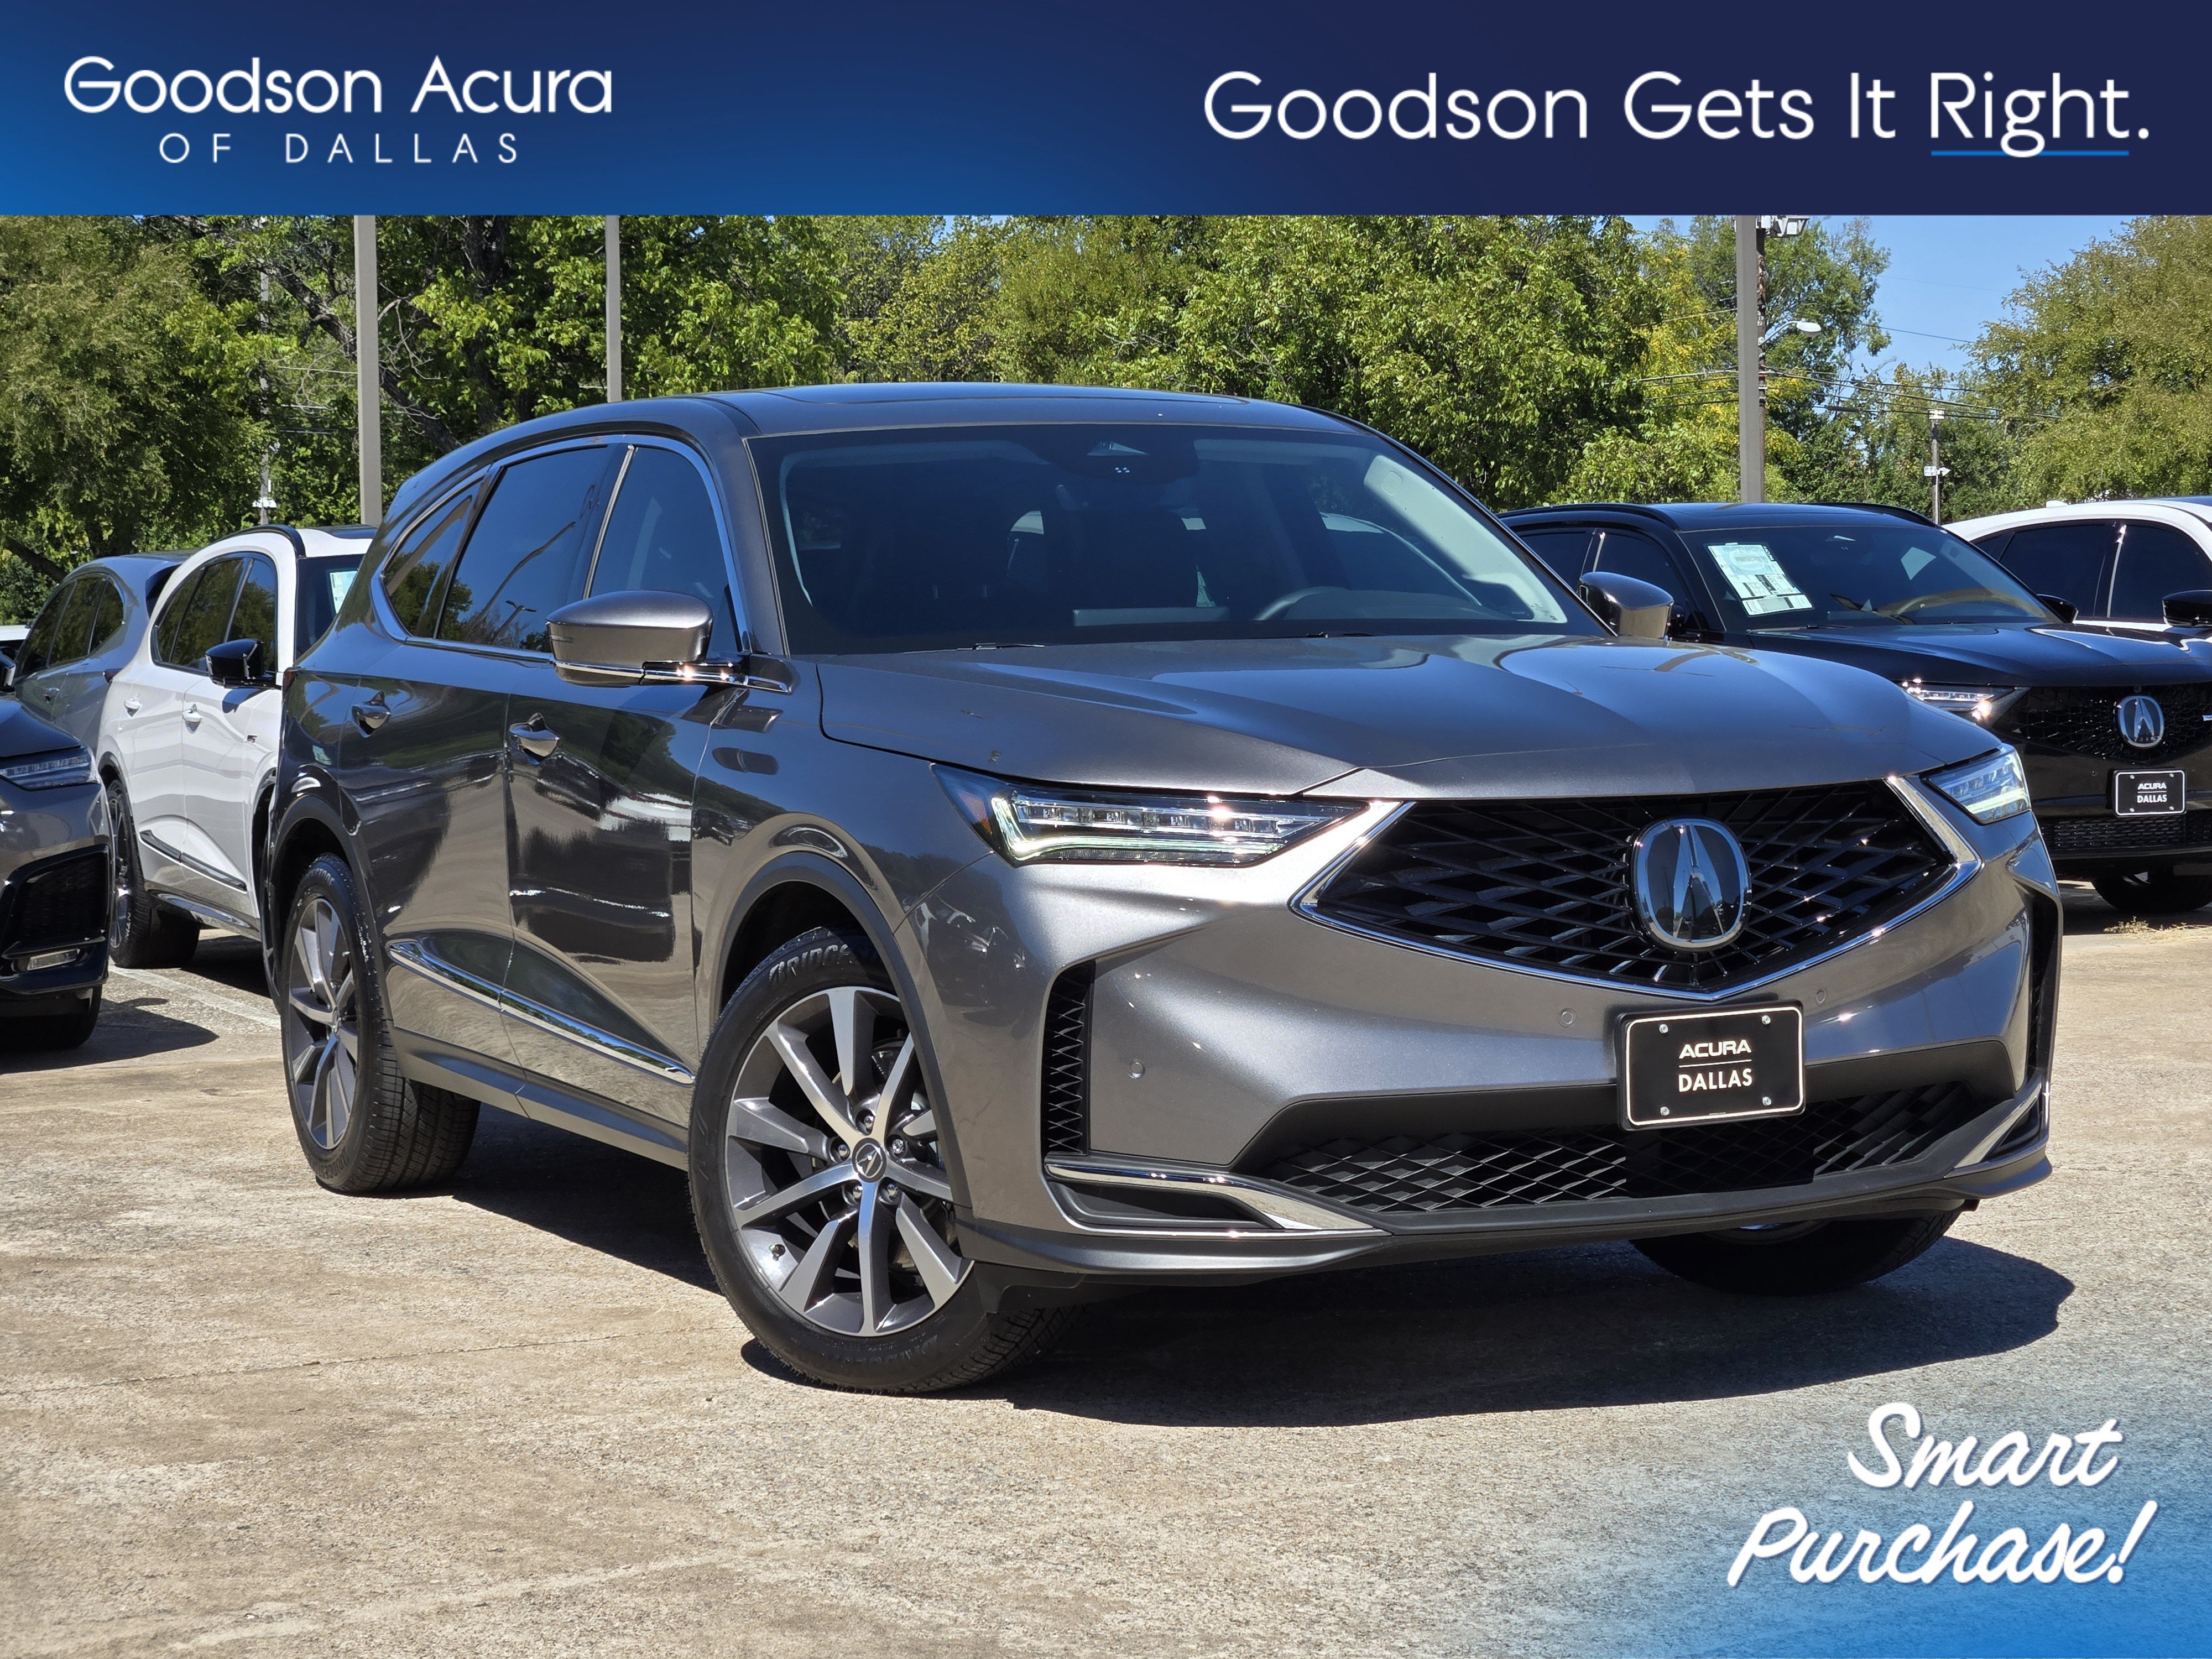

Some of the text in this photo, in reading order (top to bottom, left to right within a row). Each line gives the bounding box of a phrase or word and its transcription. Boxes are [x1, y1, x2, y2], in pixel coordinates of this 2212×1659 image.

[2137, 782, 2167, 790] ACURA
[2137, 794, 2168, 804] DALLAS
[1678, 1039, 1752, 1059] ACURA
[1678, 1068, 1753, 1093] DALLAS
